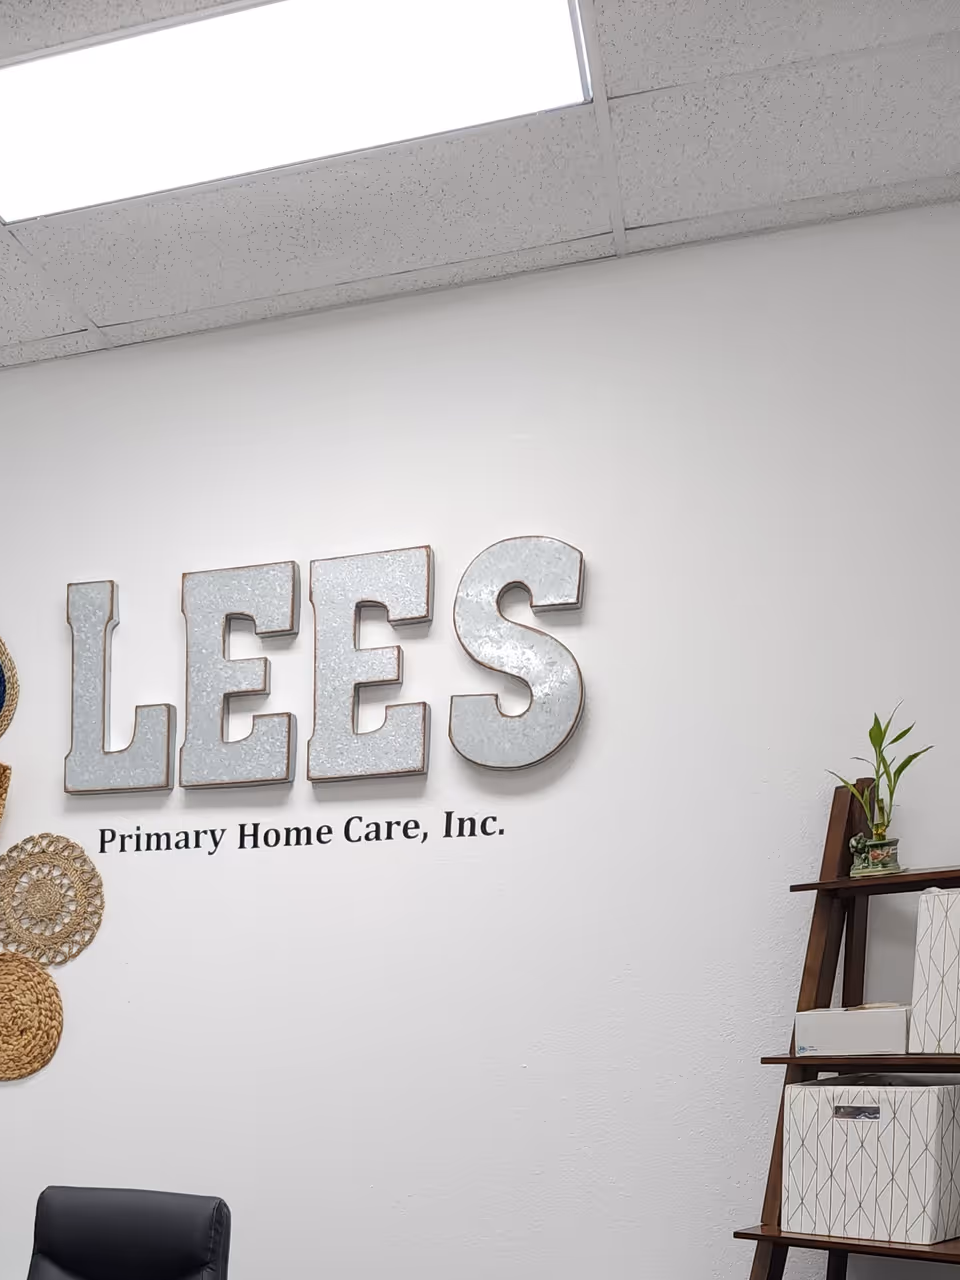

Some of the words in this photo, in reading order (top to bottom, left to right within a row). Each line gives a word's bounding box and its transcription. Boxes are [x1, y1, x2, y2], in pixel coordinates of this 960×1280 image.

[64, 535, 586, 794] LEES
[98, 826, 227, 855] Primary
[238, 822, 333, 849] Home
[343, 815, 429, 844] Care,
[442, 810, 505, 838] Inc.
